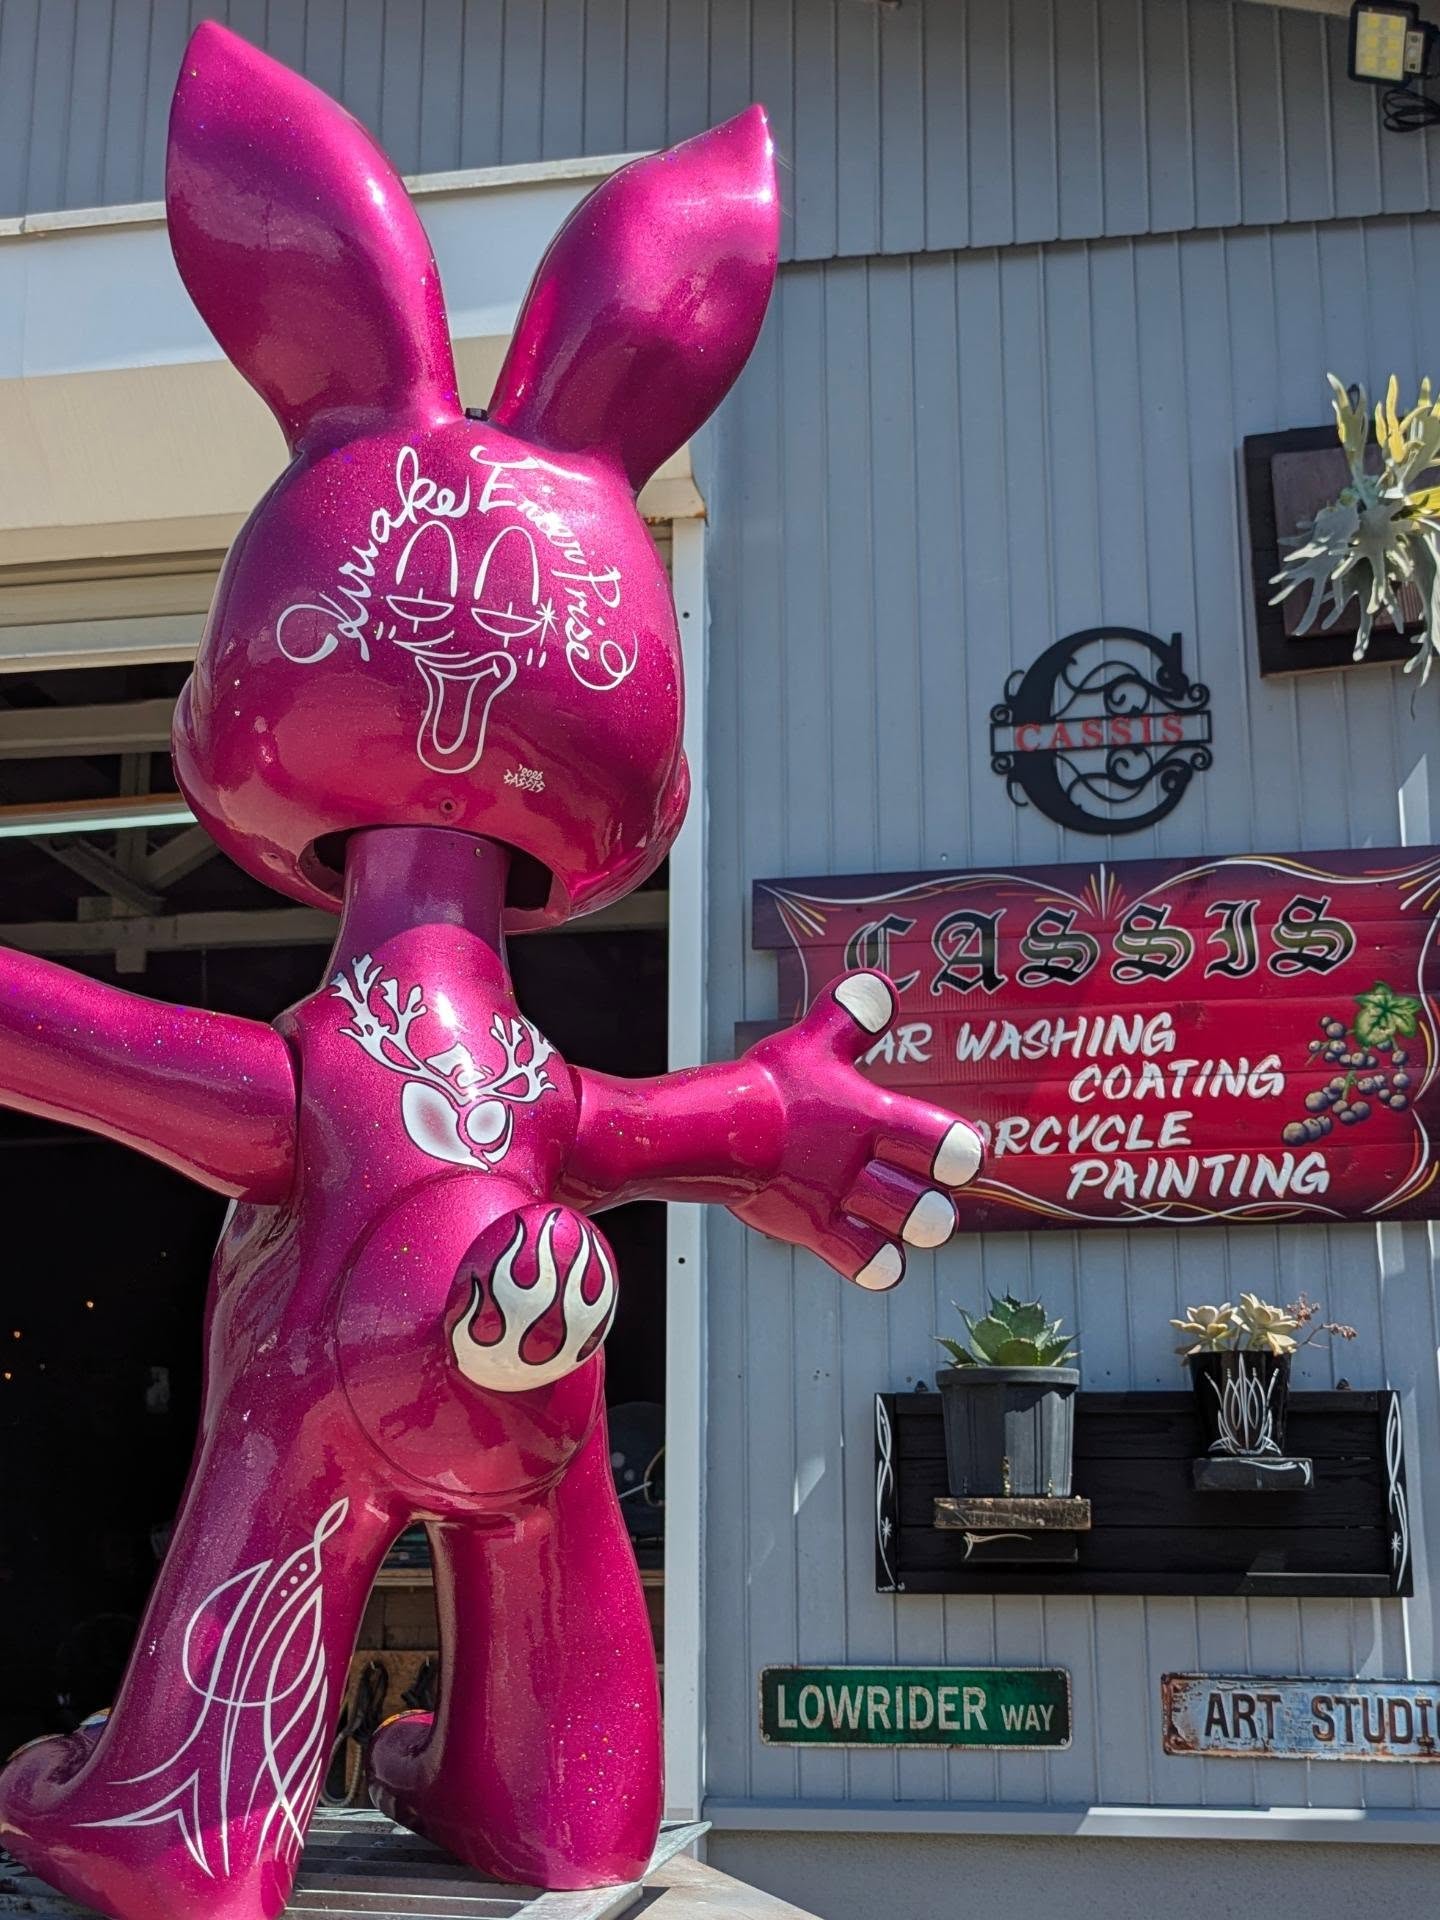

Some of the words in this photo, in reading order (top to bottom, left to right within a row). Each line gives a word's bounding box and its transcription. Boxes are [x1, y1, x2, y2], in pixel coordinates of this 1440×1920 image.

[1015, 715, 1183, 752] CASSIS
[844, 896, 1356, 995] CASSIS
[854, 1022, 933, 1066] AR
[957, 1013, 1175, 1062] WASHING
[1070, 1056, 1285, 1102] COATING
[1066, 1152, 1330, 1200] PAINTING
[777, 1684, 989, 1731] LOWRIDER
[1001, 1702, 1055, 1732] WAY
[1204, 1692, 1282, 1740] ART
[1312, 1695, 1440, 1747] STUDI
